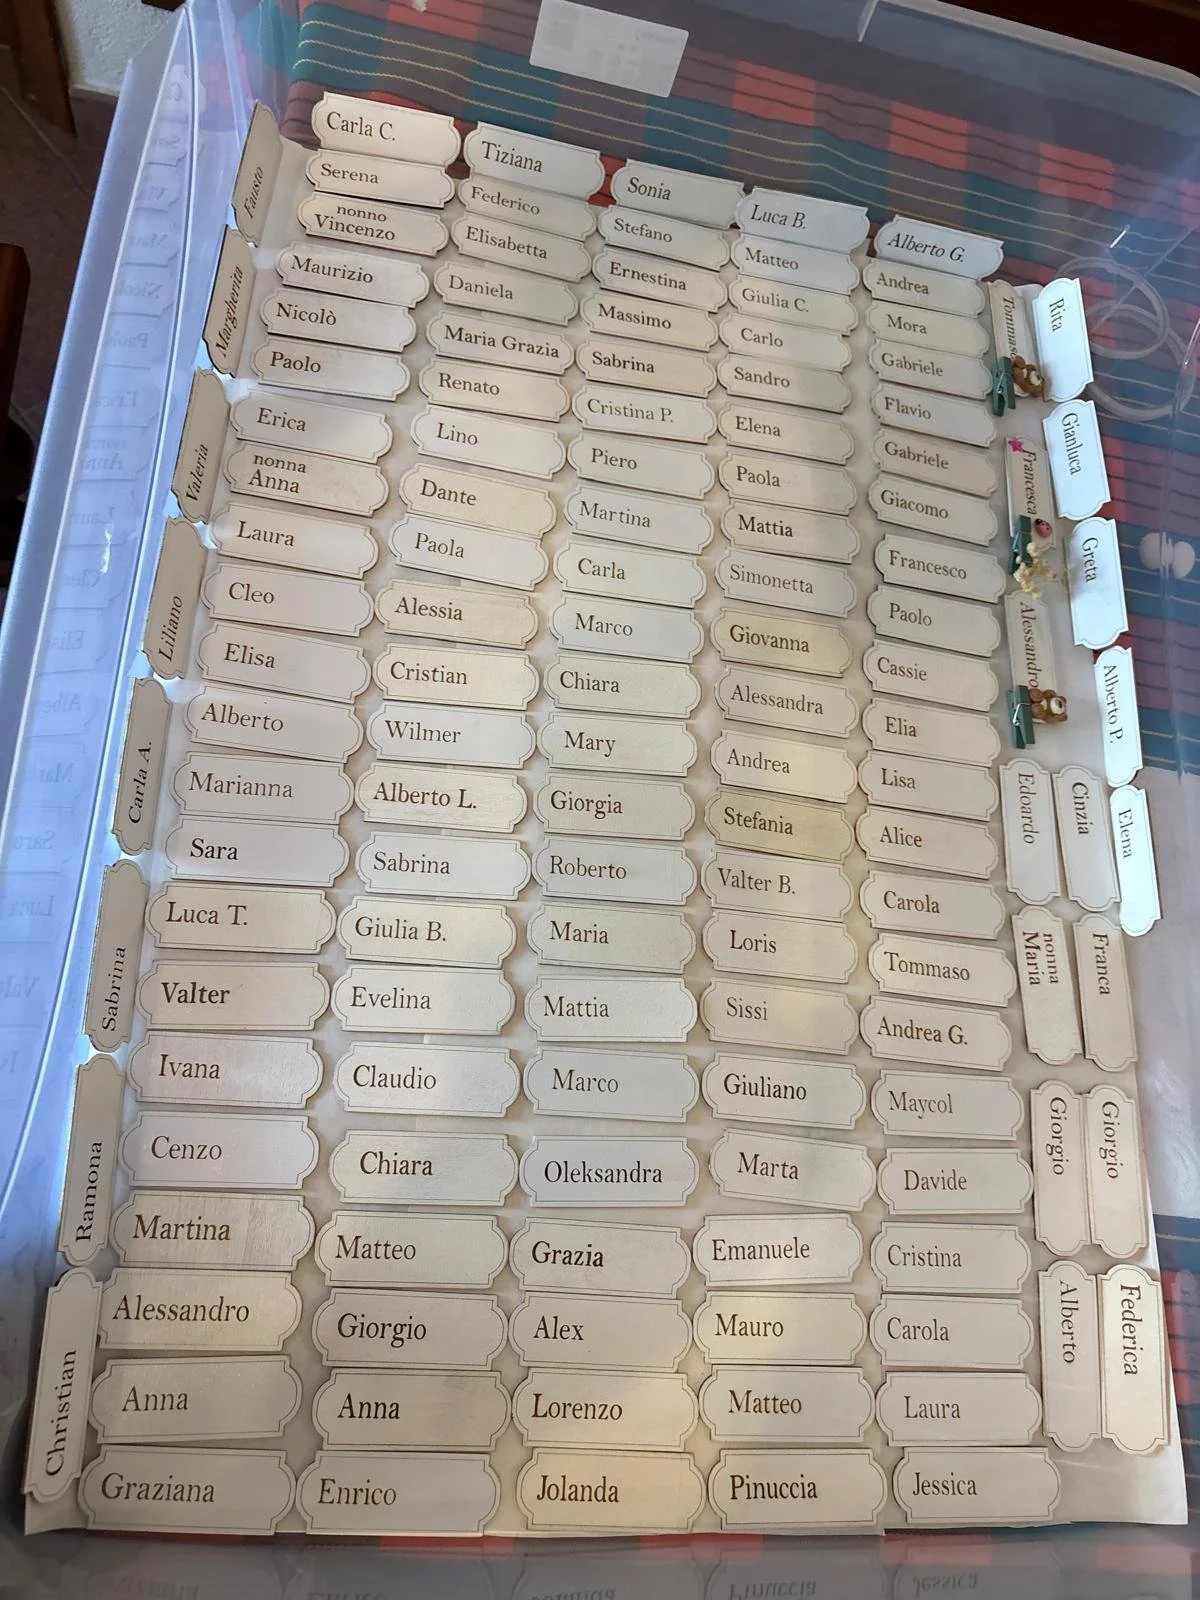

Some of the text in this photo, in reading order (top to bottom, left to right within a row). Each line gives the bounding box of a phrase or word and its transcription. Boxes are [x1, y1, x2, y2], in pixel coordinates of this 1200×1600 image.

[326, 112, 395, 141] Carla C.
[481, 141, 543, 173] Tiziana
[320, 164, 379, 184] Serena
[243, 165, 263, 220] Fausto
[471, 186, 540, 215] Federico
[627, 177, 671, 200] Sonia
[337, 205, 387, 222] nonno
[751, 205, 807, 230] Luca B.
[314, 215, 395, 241] Vincenzo
[613, 219, 673, 243] Stefano
[466, 227, 547, 259] Elisabetta
[887, 233, 963, 262] Alberto G.
[291, 256, 373, 284] Maurizio
[745, 248, 799, 270] Matteo
[449, 276, 514, 299] Daniela
[609, 262, 687, 290] Ernestina
[876, 272, 930, 295] Andrea
[216, 265, 244, 357] Margherita
[742, 288, 809, 312] Giulia C.
[276, 303, 337, 326] Nicolò
[598, 304, 671, 330] Massimo
[887, 315, 927, 335] Mora
[1049, 298, 1063, 332] Rita
[445, 326, 559, 359] Maria Grazia
[740, 327, 783, 348] Carlo
[270, 352, 321, 374] Paolo
[592, 352, 654, 374] Sabrina
[882, 352, 943, 376] Gabriele
[438, 373, 500, 396] Renato
[734, 367, 790, 388] Sandro
[257, 408, 306, 432] Erica
[587, 399, 673, 422] Cristina P.
[884, 397, 931, 420] Flavio
[437, 423, 478, 446] Lino
[735, 416, 781, 437] Elena
[885, 442, 948, 470] Gabriele
[1062, 412, 1081, 476] Gianluca
[253, 455, 306, 473] nonna
[591, 448, 637, 470] Piero
[186, 443, 208, 504] Valeria
[248, 470, 299, 493] Anna
[736, 466, 780, 488] Paola
[1022, 449, 1037, 515] Francesca
[420, 479, 476, 506] Dante
[881, 490, 948, 520] Giacomo
[580, 502, 651, 528] Martina
[738, 516, 793, 537] Mattia
[237, 521, 295, 547] Laura
[415, 533, 464, 559] Paola
[577, 558, 626, 580] Carla
[889, 551, 967, 581] Francesco
[1082, 537, 1097, 582] Greta
[729, 564, 814, 595] Simonetta
[229, 582, 274, 604] Cleo
[395, 598, 463, 622] Alessia
[889, 603, 932, 627] Paolo
[158, 596, 183, 661] Liliano
[575, 614, 633, 636] Marco
[729, 625, 809, 653] Giovanna
[1020, 602, 1042, 688] Alessandro
[224, 643, 275, 669] Elisa
[390, 662, 467, 685] Cristian
[560, 671, 619, 693] Chiara
[877, 658, 927, 681] Cassie
[731, 685, 823, 715] Alessandra
[1104, 665, 1124, 744] Alberto P.
[201, 703, 283, 733] Alberto
[884, 717, 917, 737] Elia
[384, 721, 461, 743] Wilmer
[564, 731, 616, 757] Mary
[727, 749, 790, 774] Andrea
[128, 740, 153, 825] Carla A.
[188, 772, 293, 799] Marianna
[881, 768, 916, 789] Lisa
[373, 782, 477, 809] Alberto L.
[550, 791, 622, 819] Giorgia
[1071, 781, 1088, 835] Cinzia
[724, 807, 793, 835] Stefania
[1017, 773, 1035, 844] Edoardo
[880, 825, 922, 848] Alice
[1118, 809, 1132, 859] Elena
[190, 838, 238, 860] Sara
[373, 852, 450, 875] Sabrina
[550, 856, 627, 880] Roberto
[718, 868, 796, 894] Valter B.
[166, 903, 248, 926] Luca T.
[883, 891, 941, 914] Carola
[355, 917, 447, 941] Giulia B.
[550, 921, 608, 944] Maria
[730, 930, 776, 954] Loris
[885, 952, 970, 981] Tommaso
[1022, 931, 1040, 986] Maria
[1043, 933, 1058, 984] nonna
[1093, 933, 1110, 995] Franca
[102, 945, 127, 1032] Sabrina
[162, 982, 230, 1004] Valter
[351, 987, 431, 1010] Evelina
[543, 996, 609, 1018] Mattia
[726, 998, 768, 1021] Sissi
[878, 1019, 968, 1045] Andrea G.
[159, 1055, 220, 1079] Ivana
[353, 1066, 436, 1090] Claudio
[552, 1069, 618, 1093] Marco
[723, 1073, 806, 1100] Giuliano
[888, 1091, 953, 1117] Maycol
[151, 1137, 222, 1160] Cenzo
[1046, 1097, 1068, 1176] Giorgio
[1099, 1100, 1119, 1178] Giorgio
[359, 1151, 433, 1176] Chiara
[544, 1160, 662, 1184] Oleksandra
[738, 1153, 799, 1180] Marta
[75, 1141, 103, 1242] Ramona
[904, 1169, 967, 1191] Davide
[132, 1215, 230, 1241] Martina
[336, 1236, 416, 1261] Matteo
[532, 1242, 604, 1268] Grazia
[711, 1237, 810, 1263] Emanuele
[887, 1245, 962, 1268] Cristina
[112, 1296, 249, 1323] Alessandro
[1060, 1280, 1077, 1364] Alberto
[337, 1313, 427, 1347] Giorgio
[533, 1317, 584, 1341] Alex
[715, 1314, 784, 1338] Mauro
[887, 1318, 950, 1342] Carola
[1119, 1283, 1140, 1376] Federica
[122, 1386, 188, 1411] Anna
[337, 1395, 400, 1420] Anna
[532, 1393, 622, 1421] Lorenzo
[728, 1390, 802, 1415] Matteo
[904, 1395, 961, 1419] Laura
[46, 1349, 76, 1476] Christian
[101, 1472, 215, 1503] Graziana
[318, 1479, 396, 1506] Enrico
[537, 1475, 618, 1503] Jolanda
[730, 1474, 818, 1500] Pinuccia
[913, 1472, 977, 1496] Jessica
